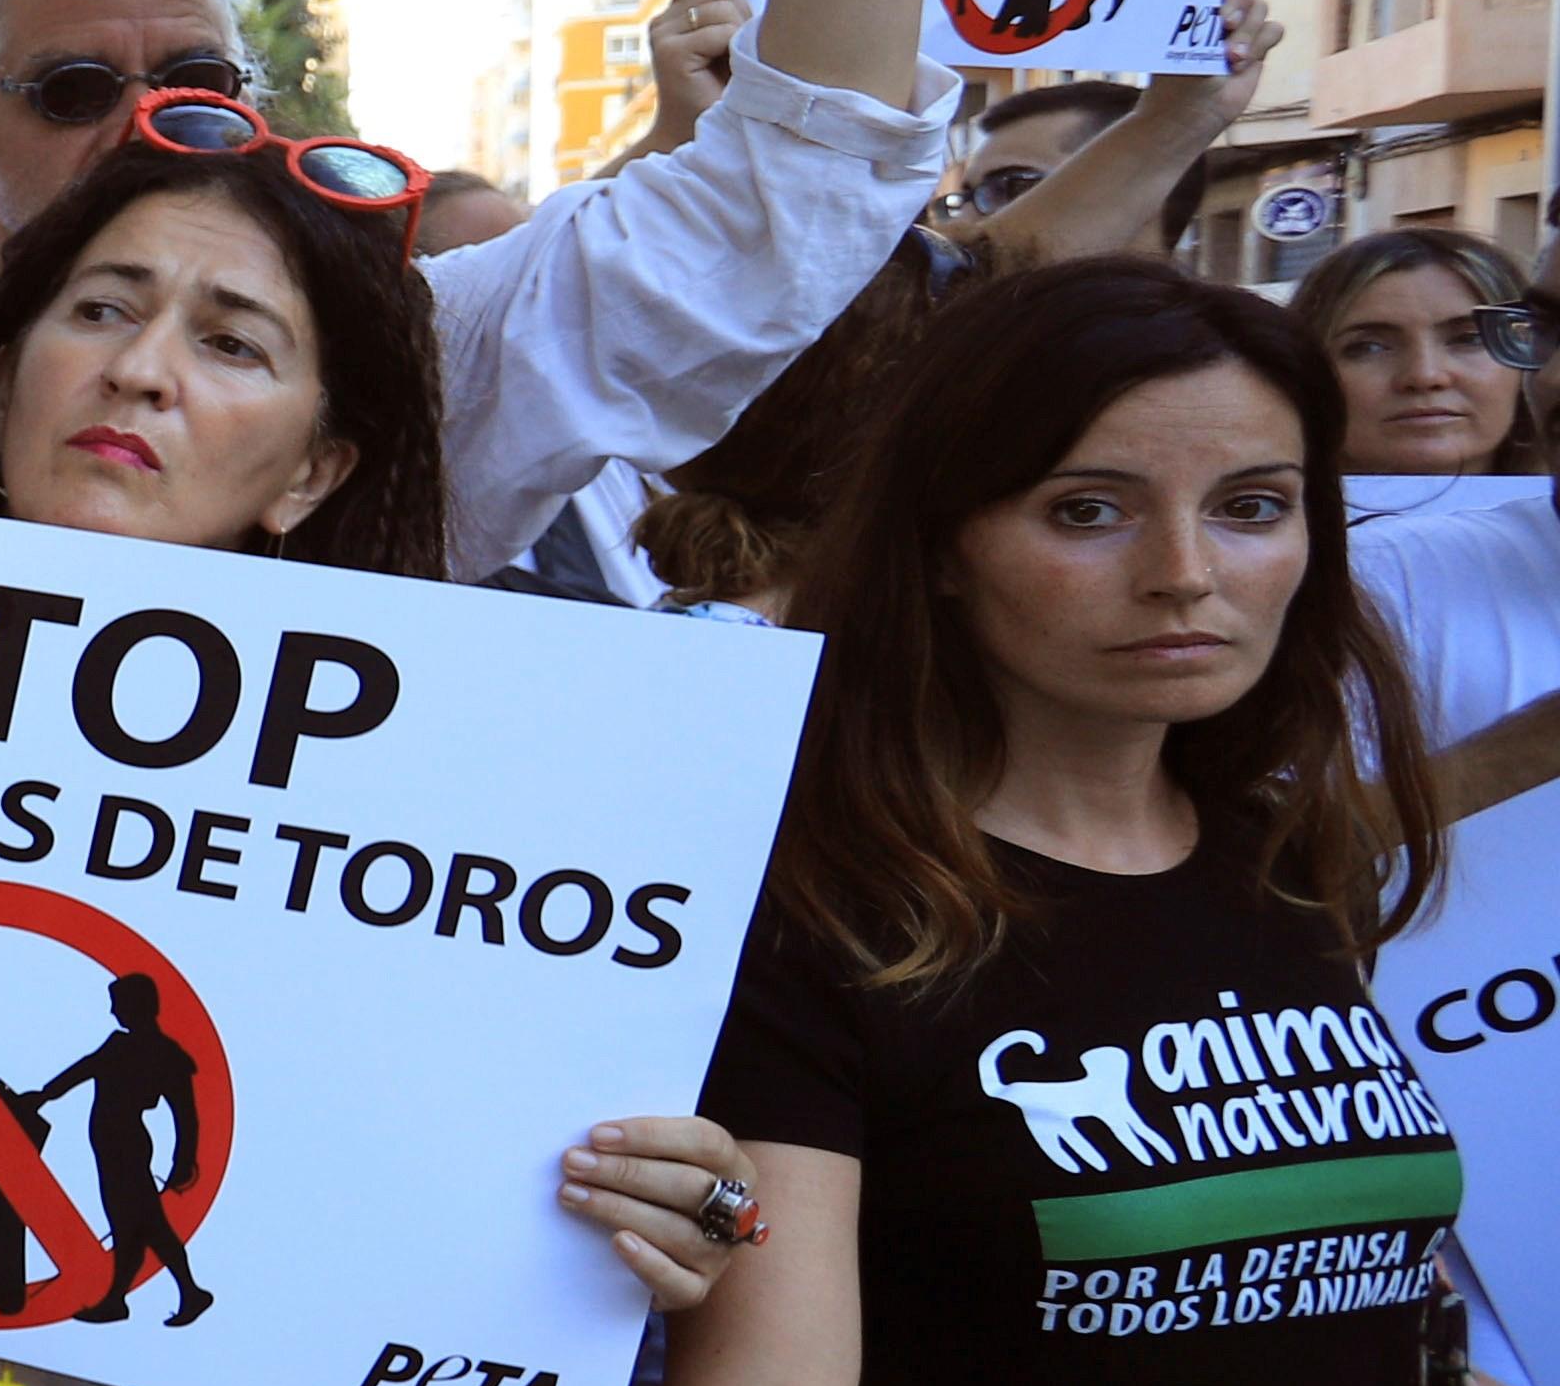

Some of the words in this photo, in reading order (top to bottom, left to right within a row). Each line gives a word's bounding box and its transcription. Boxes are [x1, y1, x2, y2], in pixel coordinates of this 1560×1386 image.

[85, 793, 253, 902] DE
[273, 821, 693, 971] TOROS
[1171, 1068, 1448, 1162] naturalis
[1041, 1265, 1159, 1301] POR
[1174, 1253, 1224, 1294] LA
[1239, 1230, 1408, 1285] DEFENSA
[1035, 1293, 1201, 1338] TODOS
[1209, 1282, 1282, 1326] LOS
